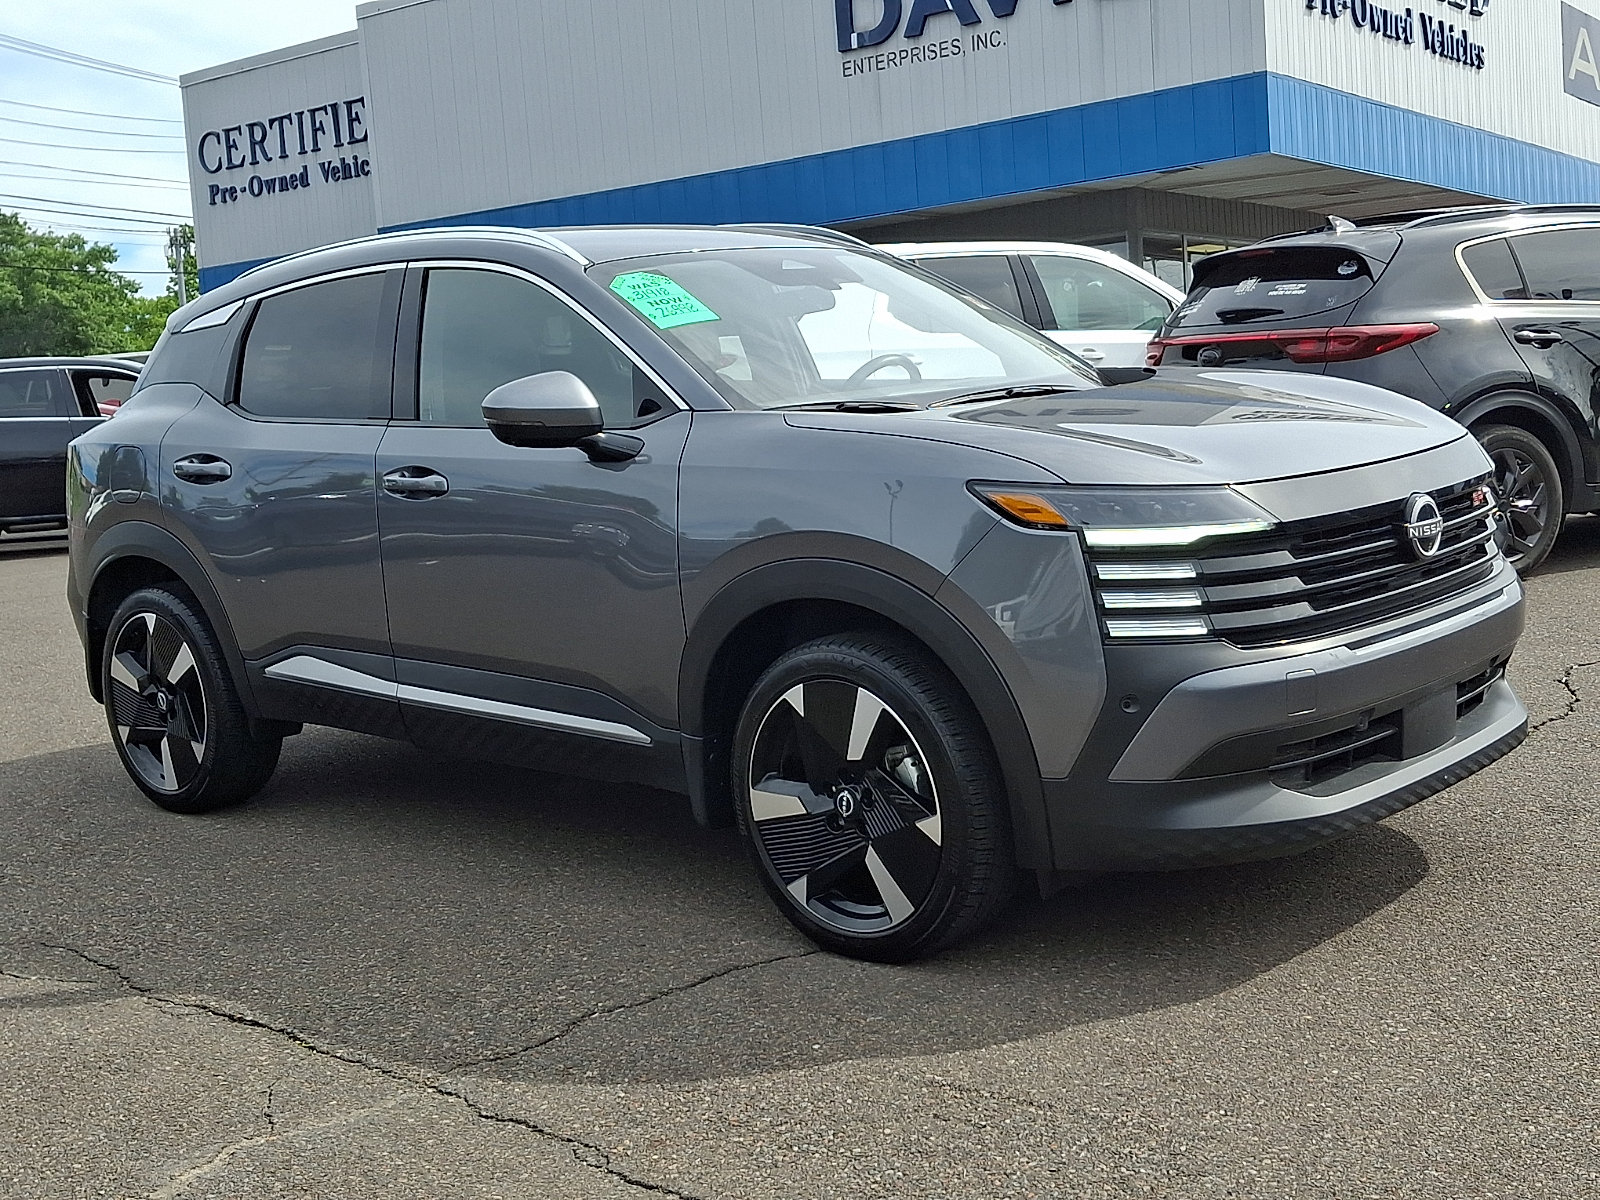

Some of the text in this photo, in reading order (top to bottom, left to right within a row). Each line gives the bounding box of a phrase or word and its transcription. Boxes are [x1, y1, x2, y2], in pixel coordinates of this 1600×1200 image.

[842, 29, 1007, 78] ENTERPRISES, INC.
[1419, 12, 1486, 70] Vehicles
[198, 96, 369, 175] CERTIFIE
[208, 164, 311, 206] Pre-Owned
[647, 296, 683, 307] NOW
